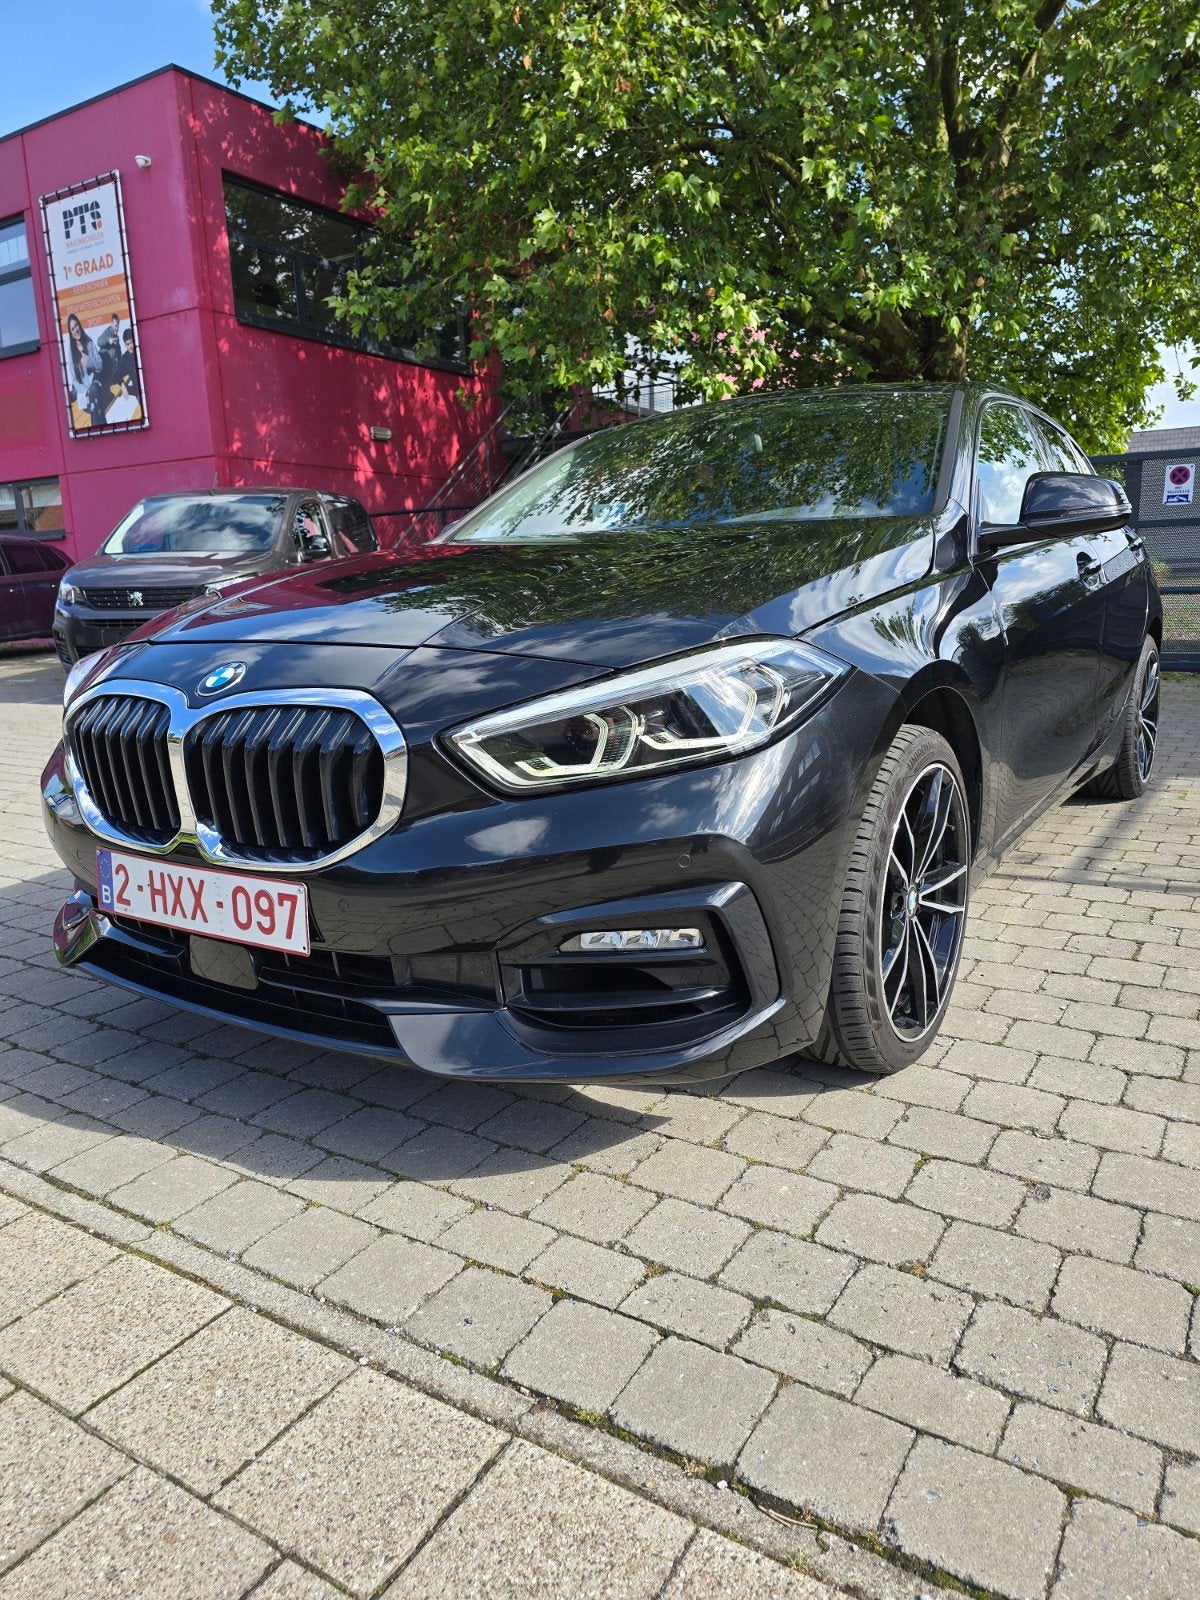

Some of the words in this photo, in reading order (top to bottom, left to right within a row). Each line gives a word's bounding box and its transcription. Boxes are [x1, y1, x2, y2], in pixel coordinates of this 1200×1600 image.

[62, 200, 102, 239] PTS
[75, 253, 114, 277] GRAAD
[906, 741, 936, 770] UNIROYAL
[102, 884, 111, 904] B
[114, 863, 298, 940] 2-HXX-097
